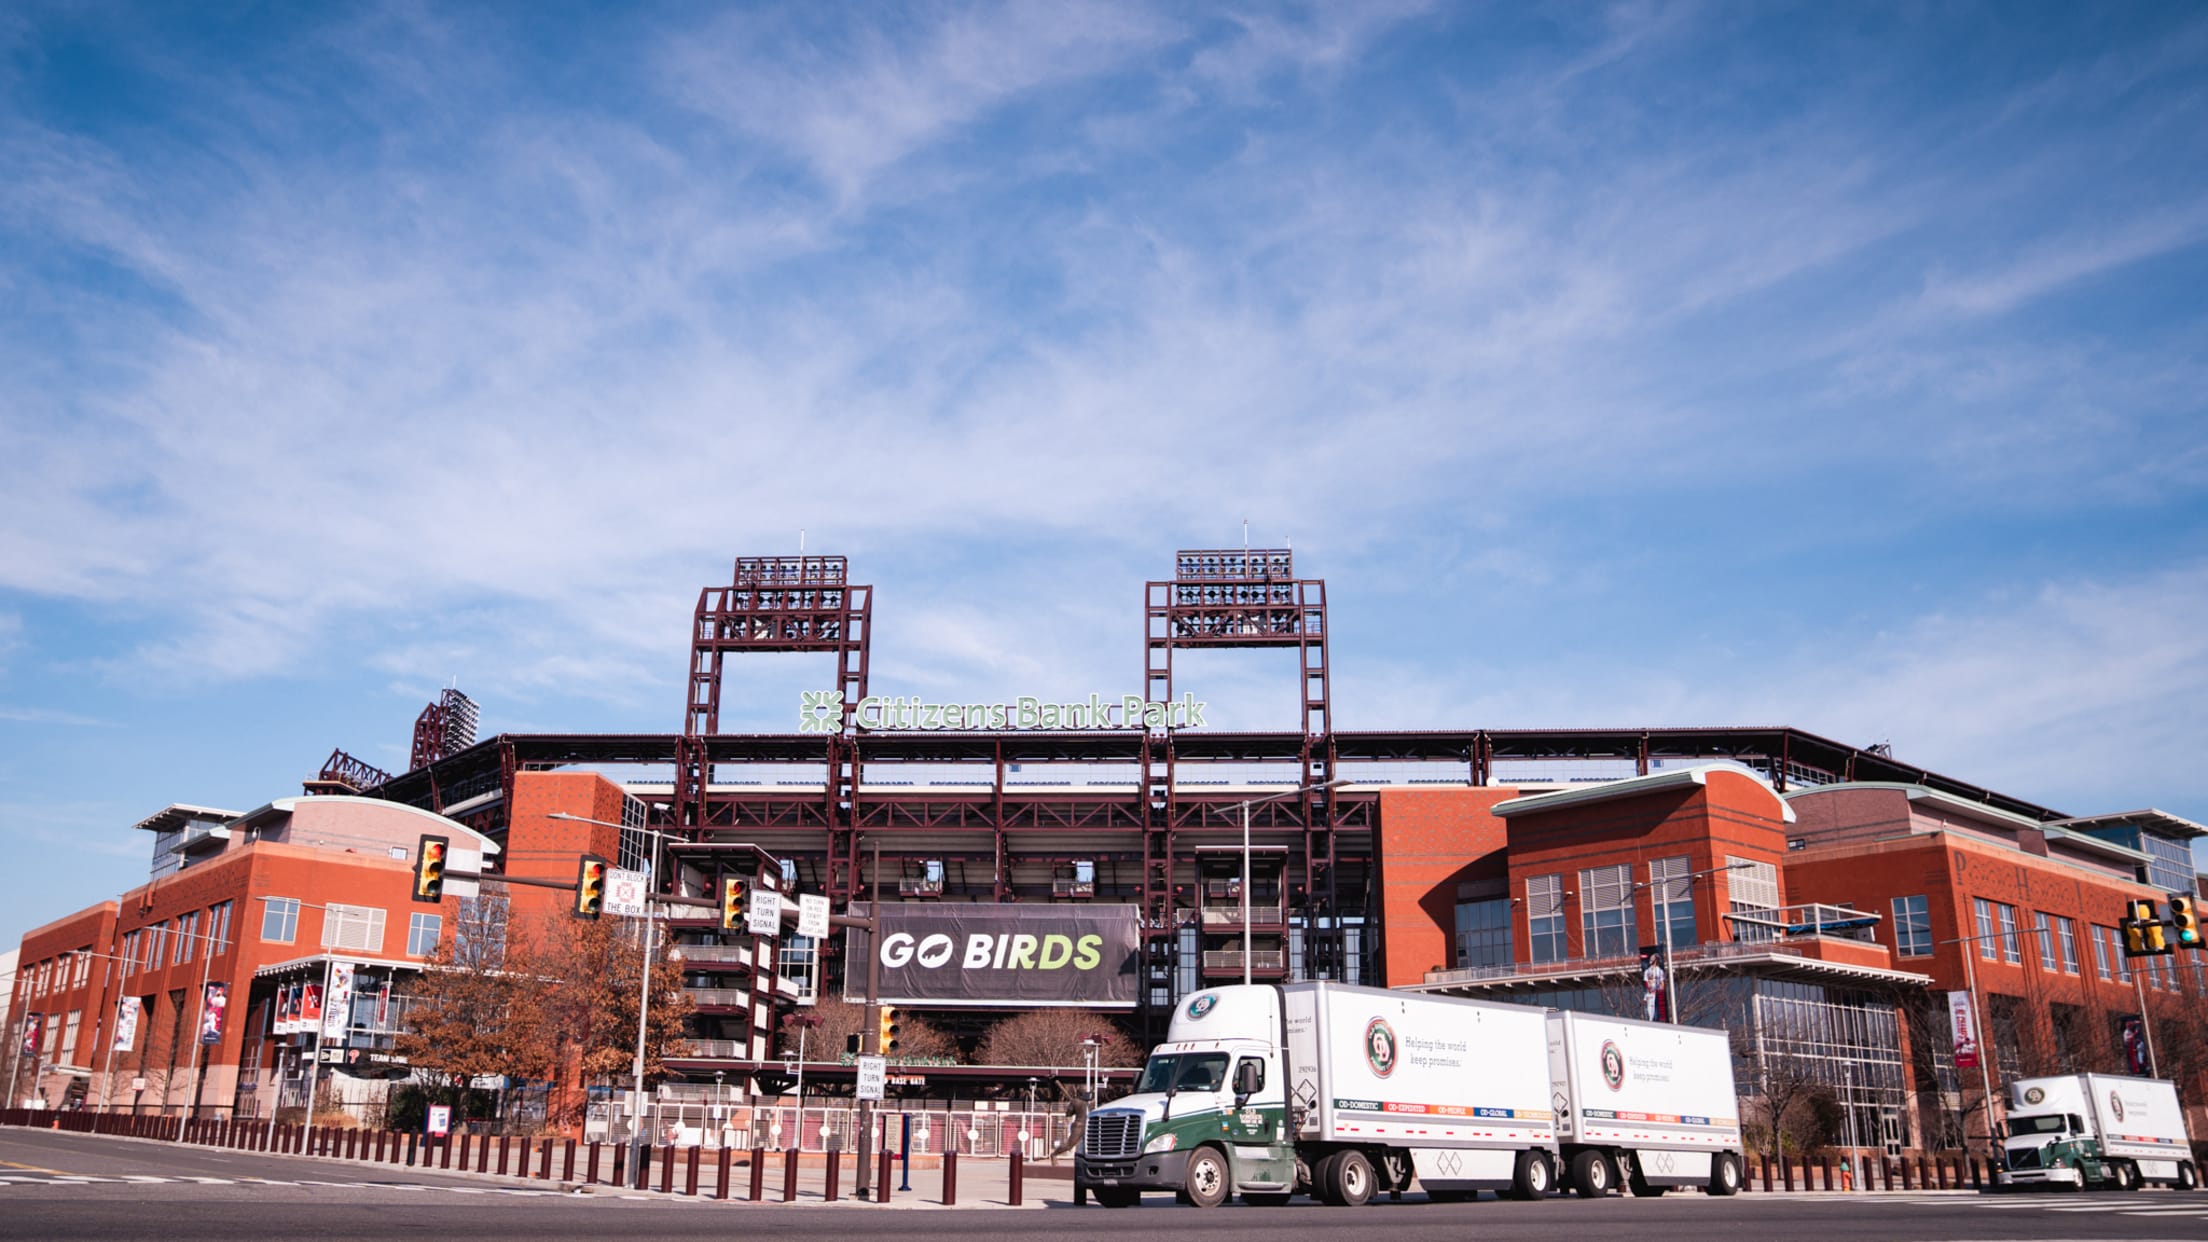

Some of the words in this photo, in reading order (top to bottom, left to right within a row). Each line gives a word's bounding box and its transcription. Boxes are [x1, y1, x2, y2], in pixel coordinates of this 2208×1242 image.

[856, 696, 1006, 729] Citizens
[1016, 692, 1112, 729] Bank
[1122, 691, 1208, 728] Park
[756, 896, 776, 905] RIGHT
[607, 902, 621, 912] THE
[625, 904, 641, 914] BOX
[756, 908, 775, 917] TURN
[753, 919, 776, 929] SIGNAL
[880, 932, 953, 969] GO
[962, 933, 1103, 971] BIRDS
[1405, 1036, 1433, 1051] Helping
[1434, 1039, 1446, 1050] the
[1447, 1040, 1467, 1052] world
[370, 1053, 389, 1062] TEAM
[1410, 1053, 1427, 1068] keep
[863, 1062, 881, 1071] RIGHT
[864, 1073, 880, 1082] TURN
[891, 1077, 907, 1085] BASE
[910, 1077, 925, 1085] GATE
[860, 1085, 881, 1095] SIGNAL
[1338, 1100, 1379, 1110] OD-DOMESTIC
